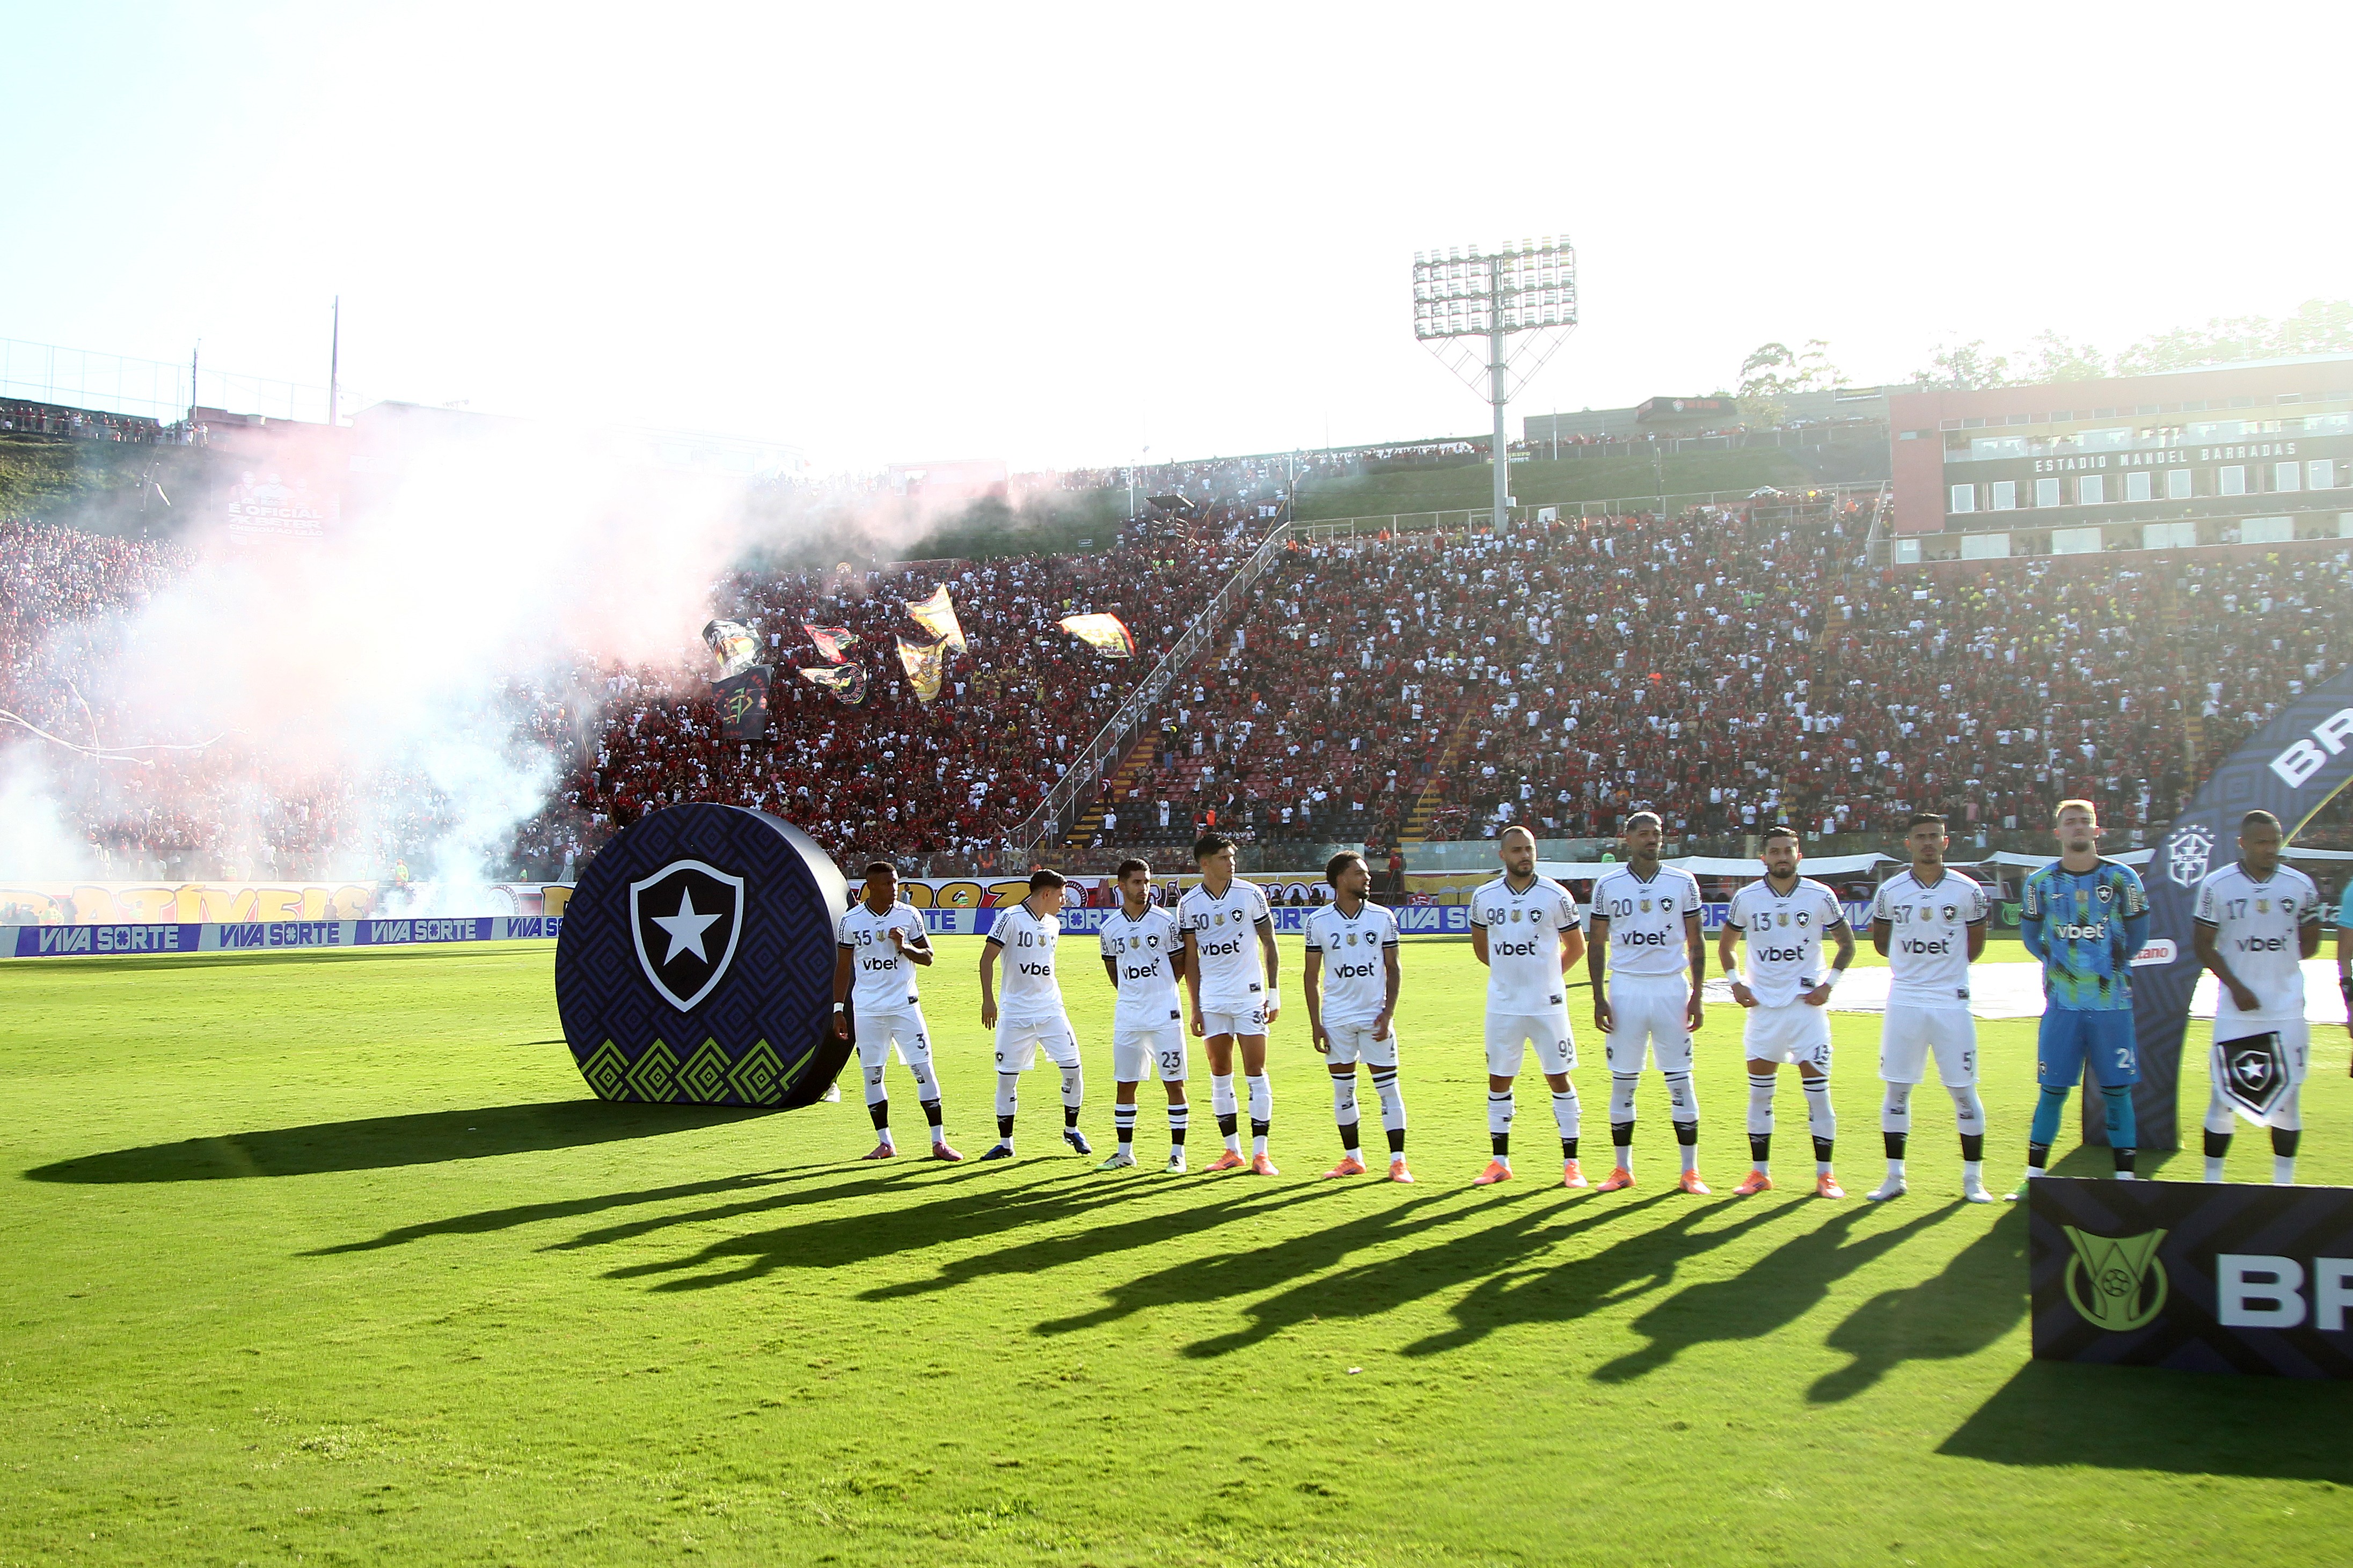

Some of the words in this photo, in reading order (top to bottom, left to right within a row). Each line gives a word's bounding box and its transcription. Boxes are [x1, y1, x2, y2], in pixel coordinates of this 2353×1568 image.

[2201, 442, 2296, 460] BARRADAS
[1611, 898, 1633, 918] 20
[2027, 884, 2035, 915] Centrum
[2226, 897, 2249, 920] 17
[1191, 913, 1209, 930] 30
[1487, 907, 1506, 925] 98
[1752, 912, 1771, 932] 13
[1893, 904, 1913, 924] 57
[371, 920, 411, 942] VIVA
[415, 919, 477, 941] SORTE
[507, 918, 542, 937] VIVA
[993, 913, 1010, 937] Centrum
[2056, 922, 2105, 940] vbet
[39, 927, 91, 952] VIVA
[97, 926, 179, 950] SORTE
[220, 924, 265, 948] VIVA
[269, 922, 340, 946] SORTE
[852, 929, 872, 946] 35
[1017, 930, 1033, 948] 10
[1330, 932, 1341, 950] 2
[1621, 929, 1667, 946] vbet
[2236, 935, 2287, 952] vbet
[1112, 936, 1126, 954] 23
[1201, 939, 1240, 956] vbet
[1494, 941, 1536, 956] vbet
[1757, 945, 1804, 962] vbet
[1902, 938, 1950, 955] vbet
[863, 957, 898, 971] vbet
[1019, 962, 1050, 976] vbe
[1122, 962, 1158, 980] vbet
[1334, 962, 1375, 979] vbet
[916, 1032, 926, 1050] 3
[1066, 1031, 1075, 1046] 1
[1684, 1037, 1692, 1057] 2
[1558, 1039, 1574, 1058] 98
[1161, 1051, 1181, 1068] 23
[1963, 1050, 1976, 1072] 5
